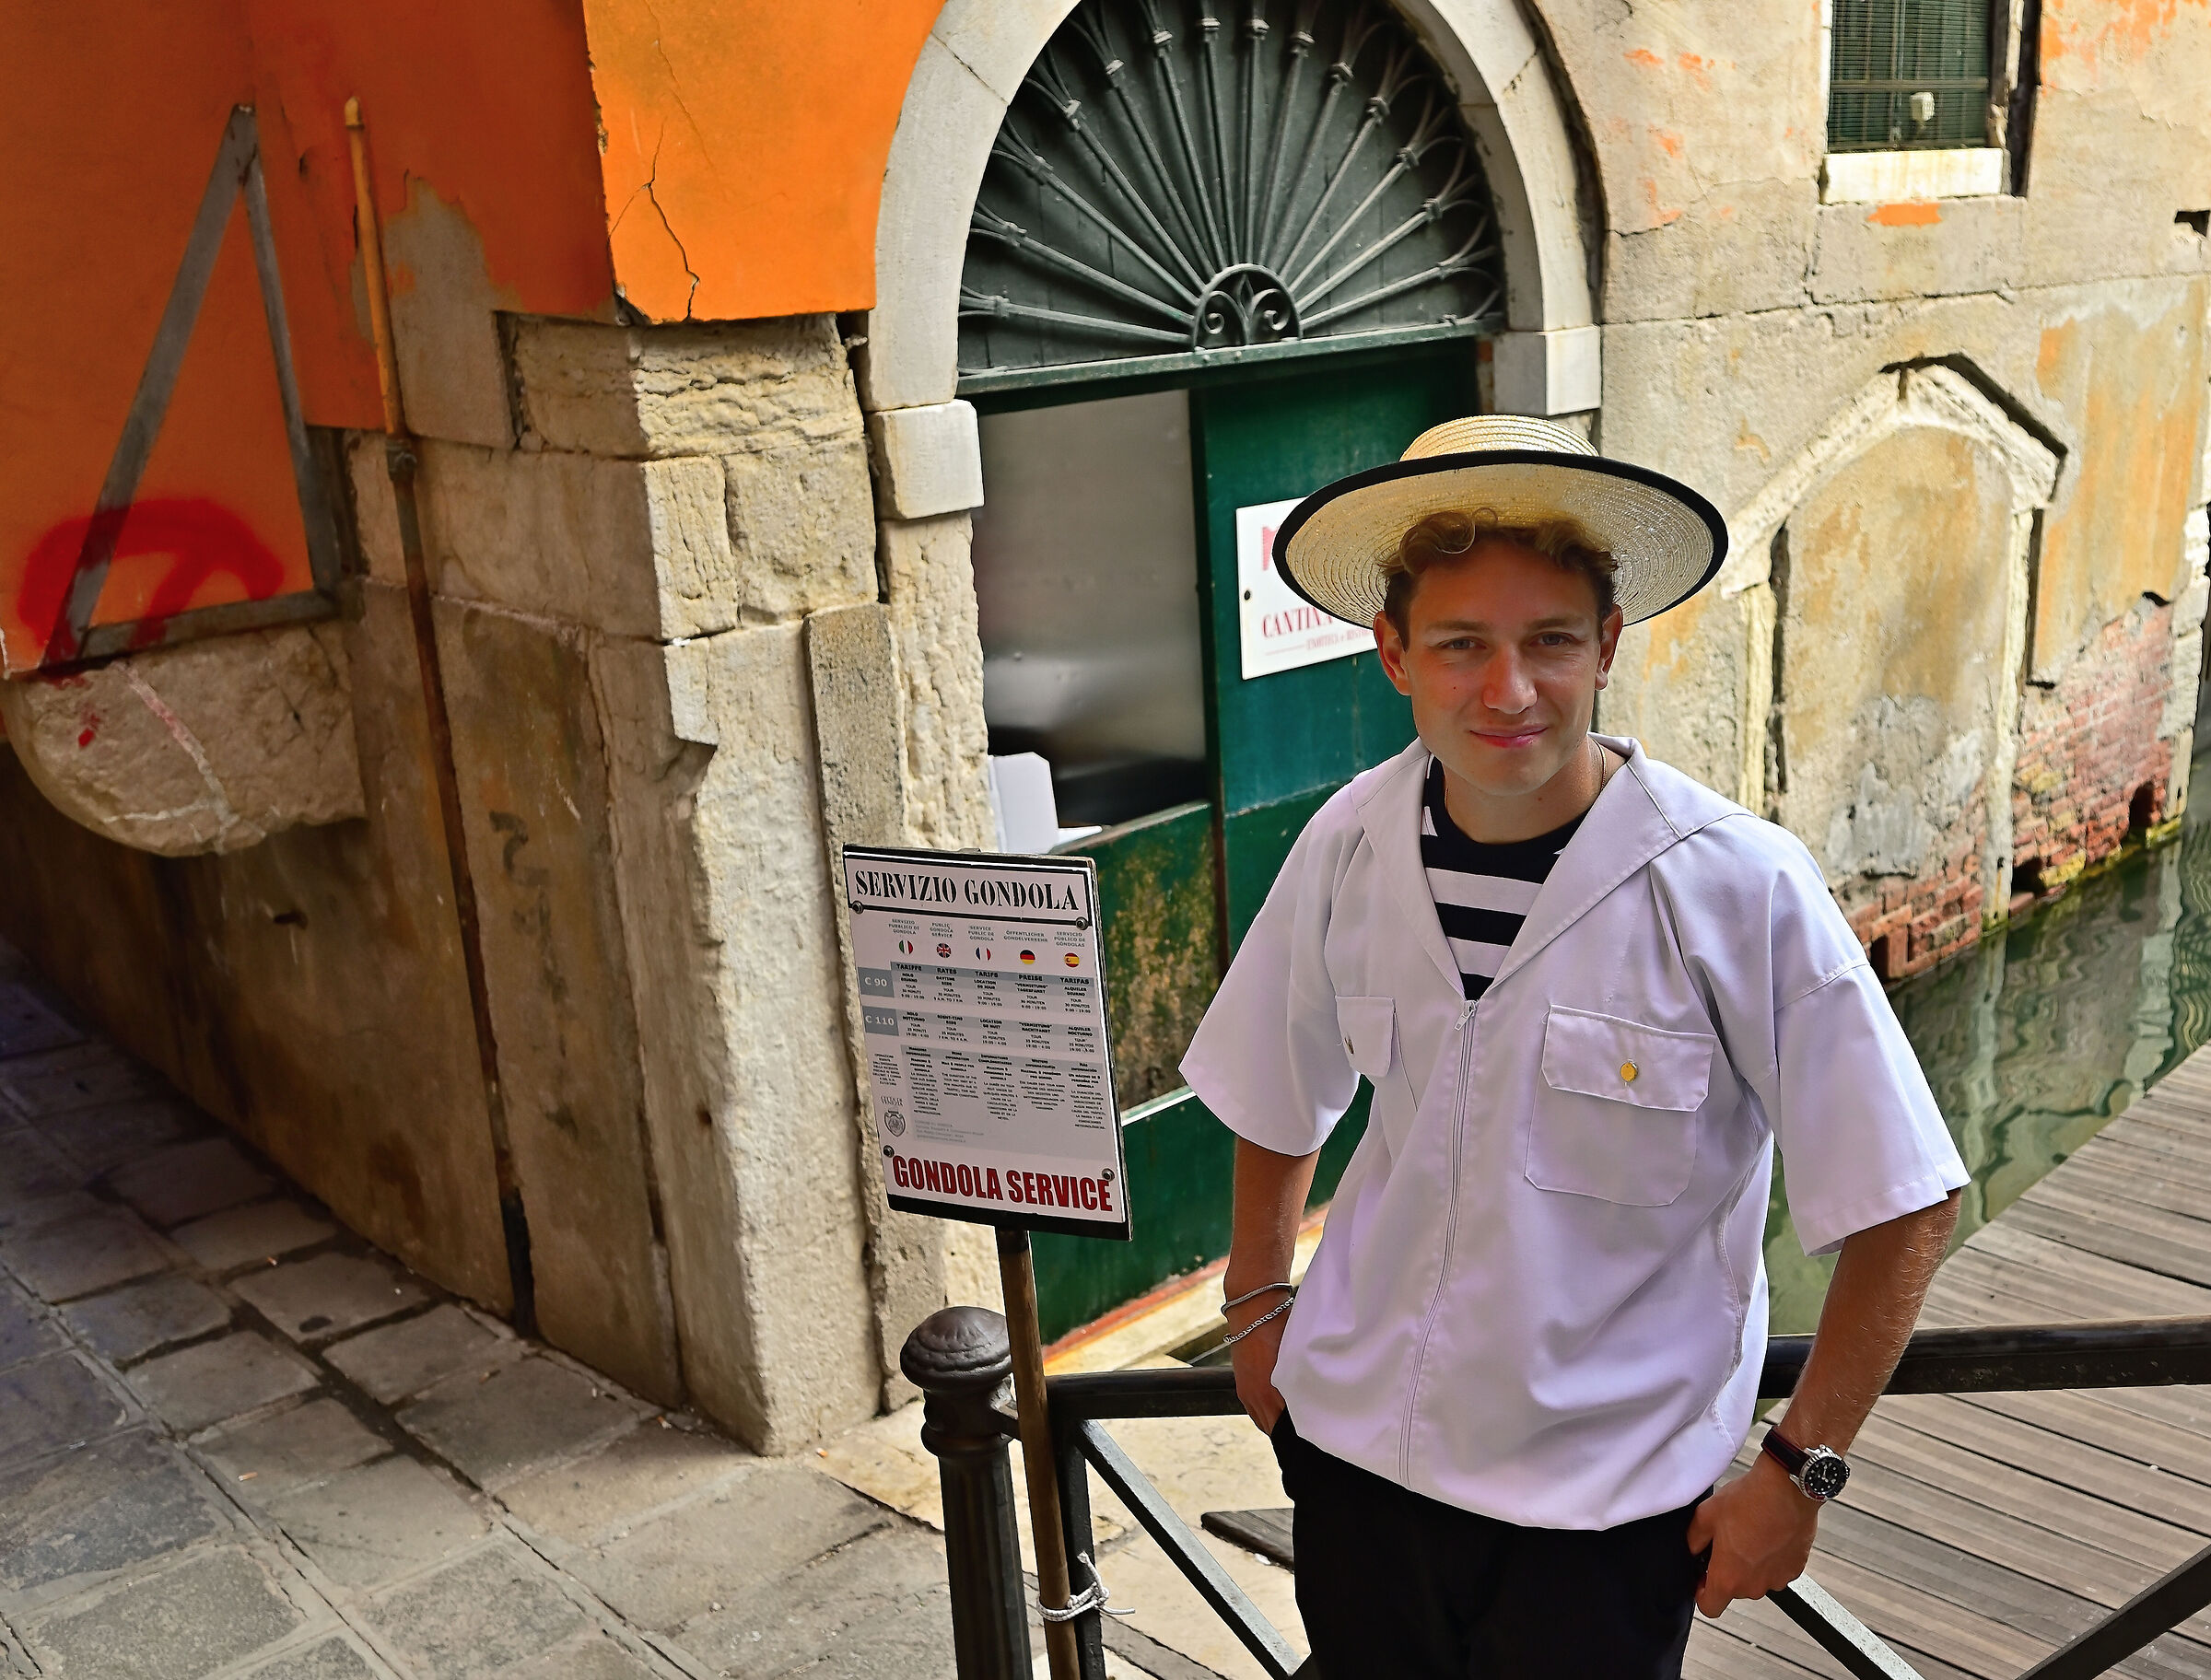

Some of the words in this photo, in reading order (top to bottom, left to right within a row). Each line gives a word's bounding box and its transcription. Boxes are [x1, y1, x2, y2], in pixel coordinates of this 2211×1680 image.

[855, 870, 957, 903] SERVIZIO
[964, 879, 1079, 910] GONDOLA
[865, 977, 871, 985] C
[874, 978, 887, 987] 90
[865, 1015, 872, 1023] C
[876, 1018, 894, 1026] 110
[893, 1155, 1002, 1201] GONDOLA
[1007, 1170, 1113, 1212] SERVICE
